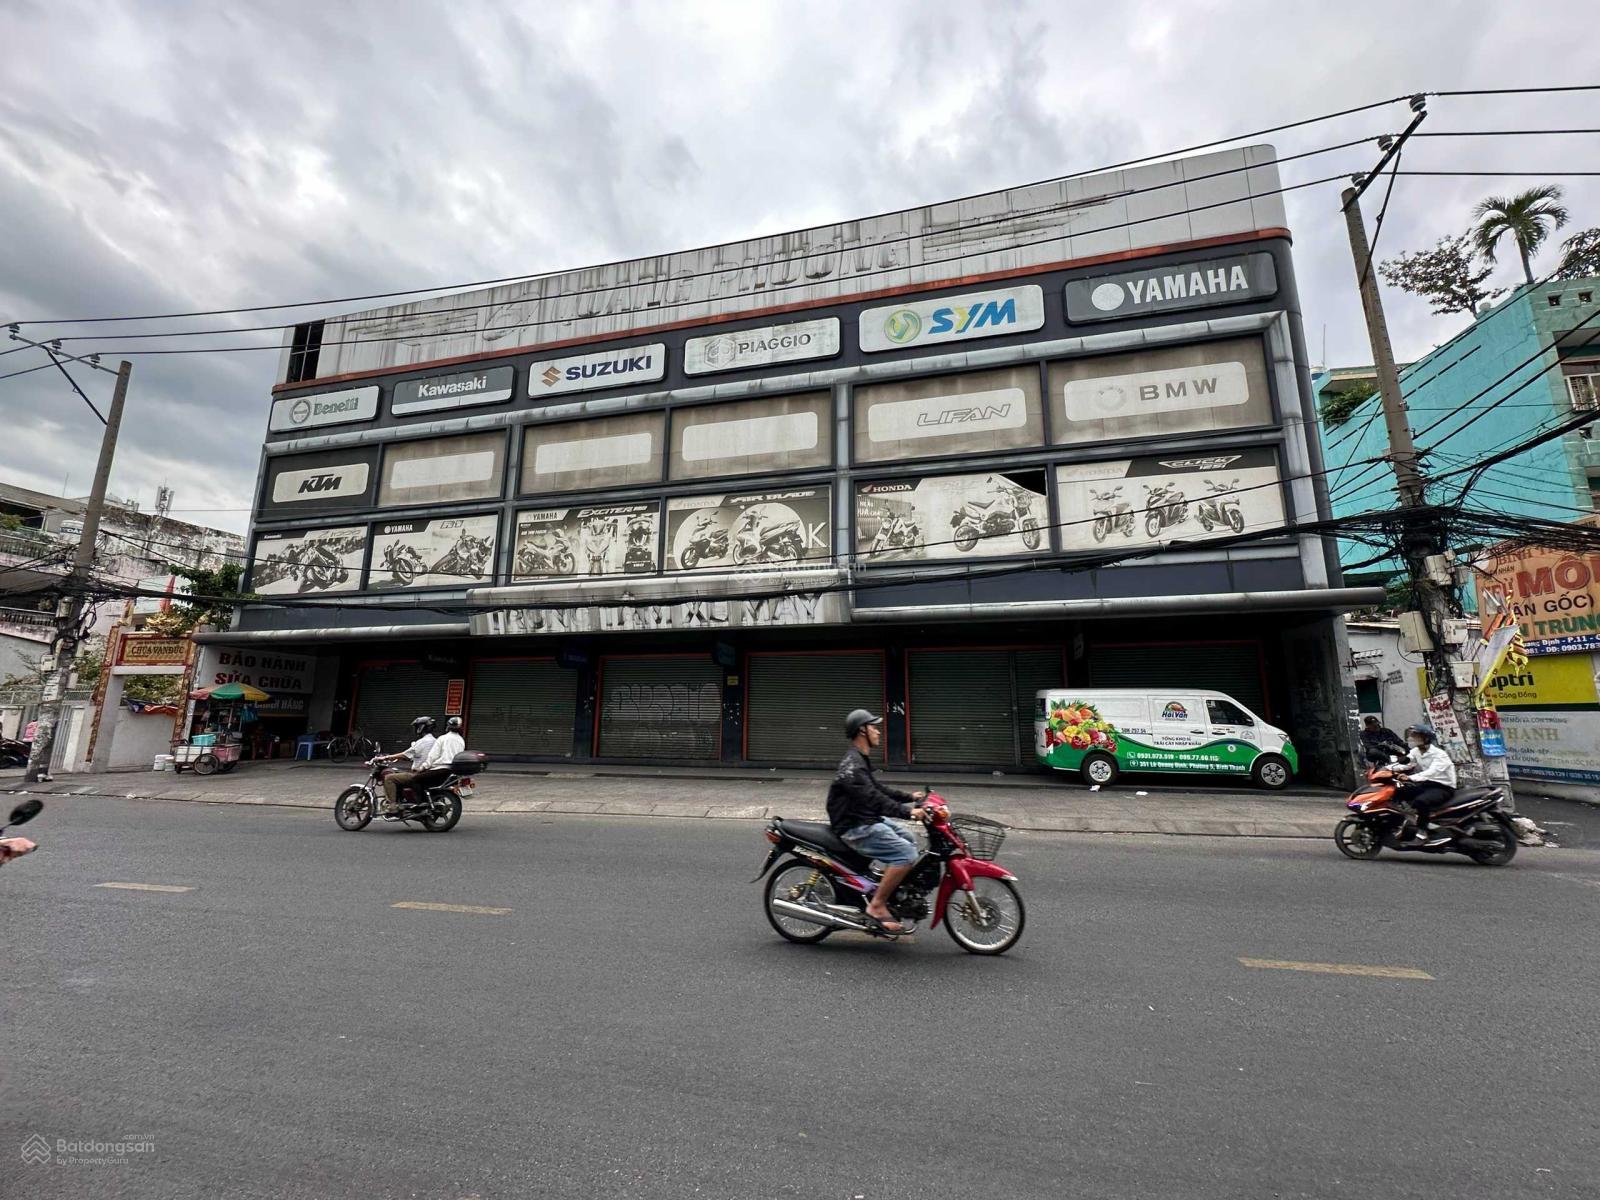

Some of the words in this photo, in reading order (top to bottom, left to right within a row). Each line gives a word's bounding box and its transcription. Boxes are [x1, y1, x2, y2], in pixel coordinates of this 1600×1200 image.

[1126, 265, 1249, 305] YAMAHA
[928, 298, 1017, 335] SYM
[737, 333, 812, 354] PIAGGIO
[565, 355, 652, 381] SUZUKI
[418, 375, 488, 398] Kawasaki
[1139, 377, 1218, 401] BMW
[313, 397, 360, 416] Benelli
[916, 403, 1011, 427] LIFAN
[297, 473, 343, 494] KTM
[872, 484, 912, 493] HONDA
[532, 512, 558, 521] YAMAHA
[391, 524, 413, 533] YAMAHA
[1543, 590, 1595, 614] GỐC)
[1567, 634, 1588, 643] P.11
[261, 655, 306, 672] HÀNH
